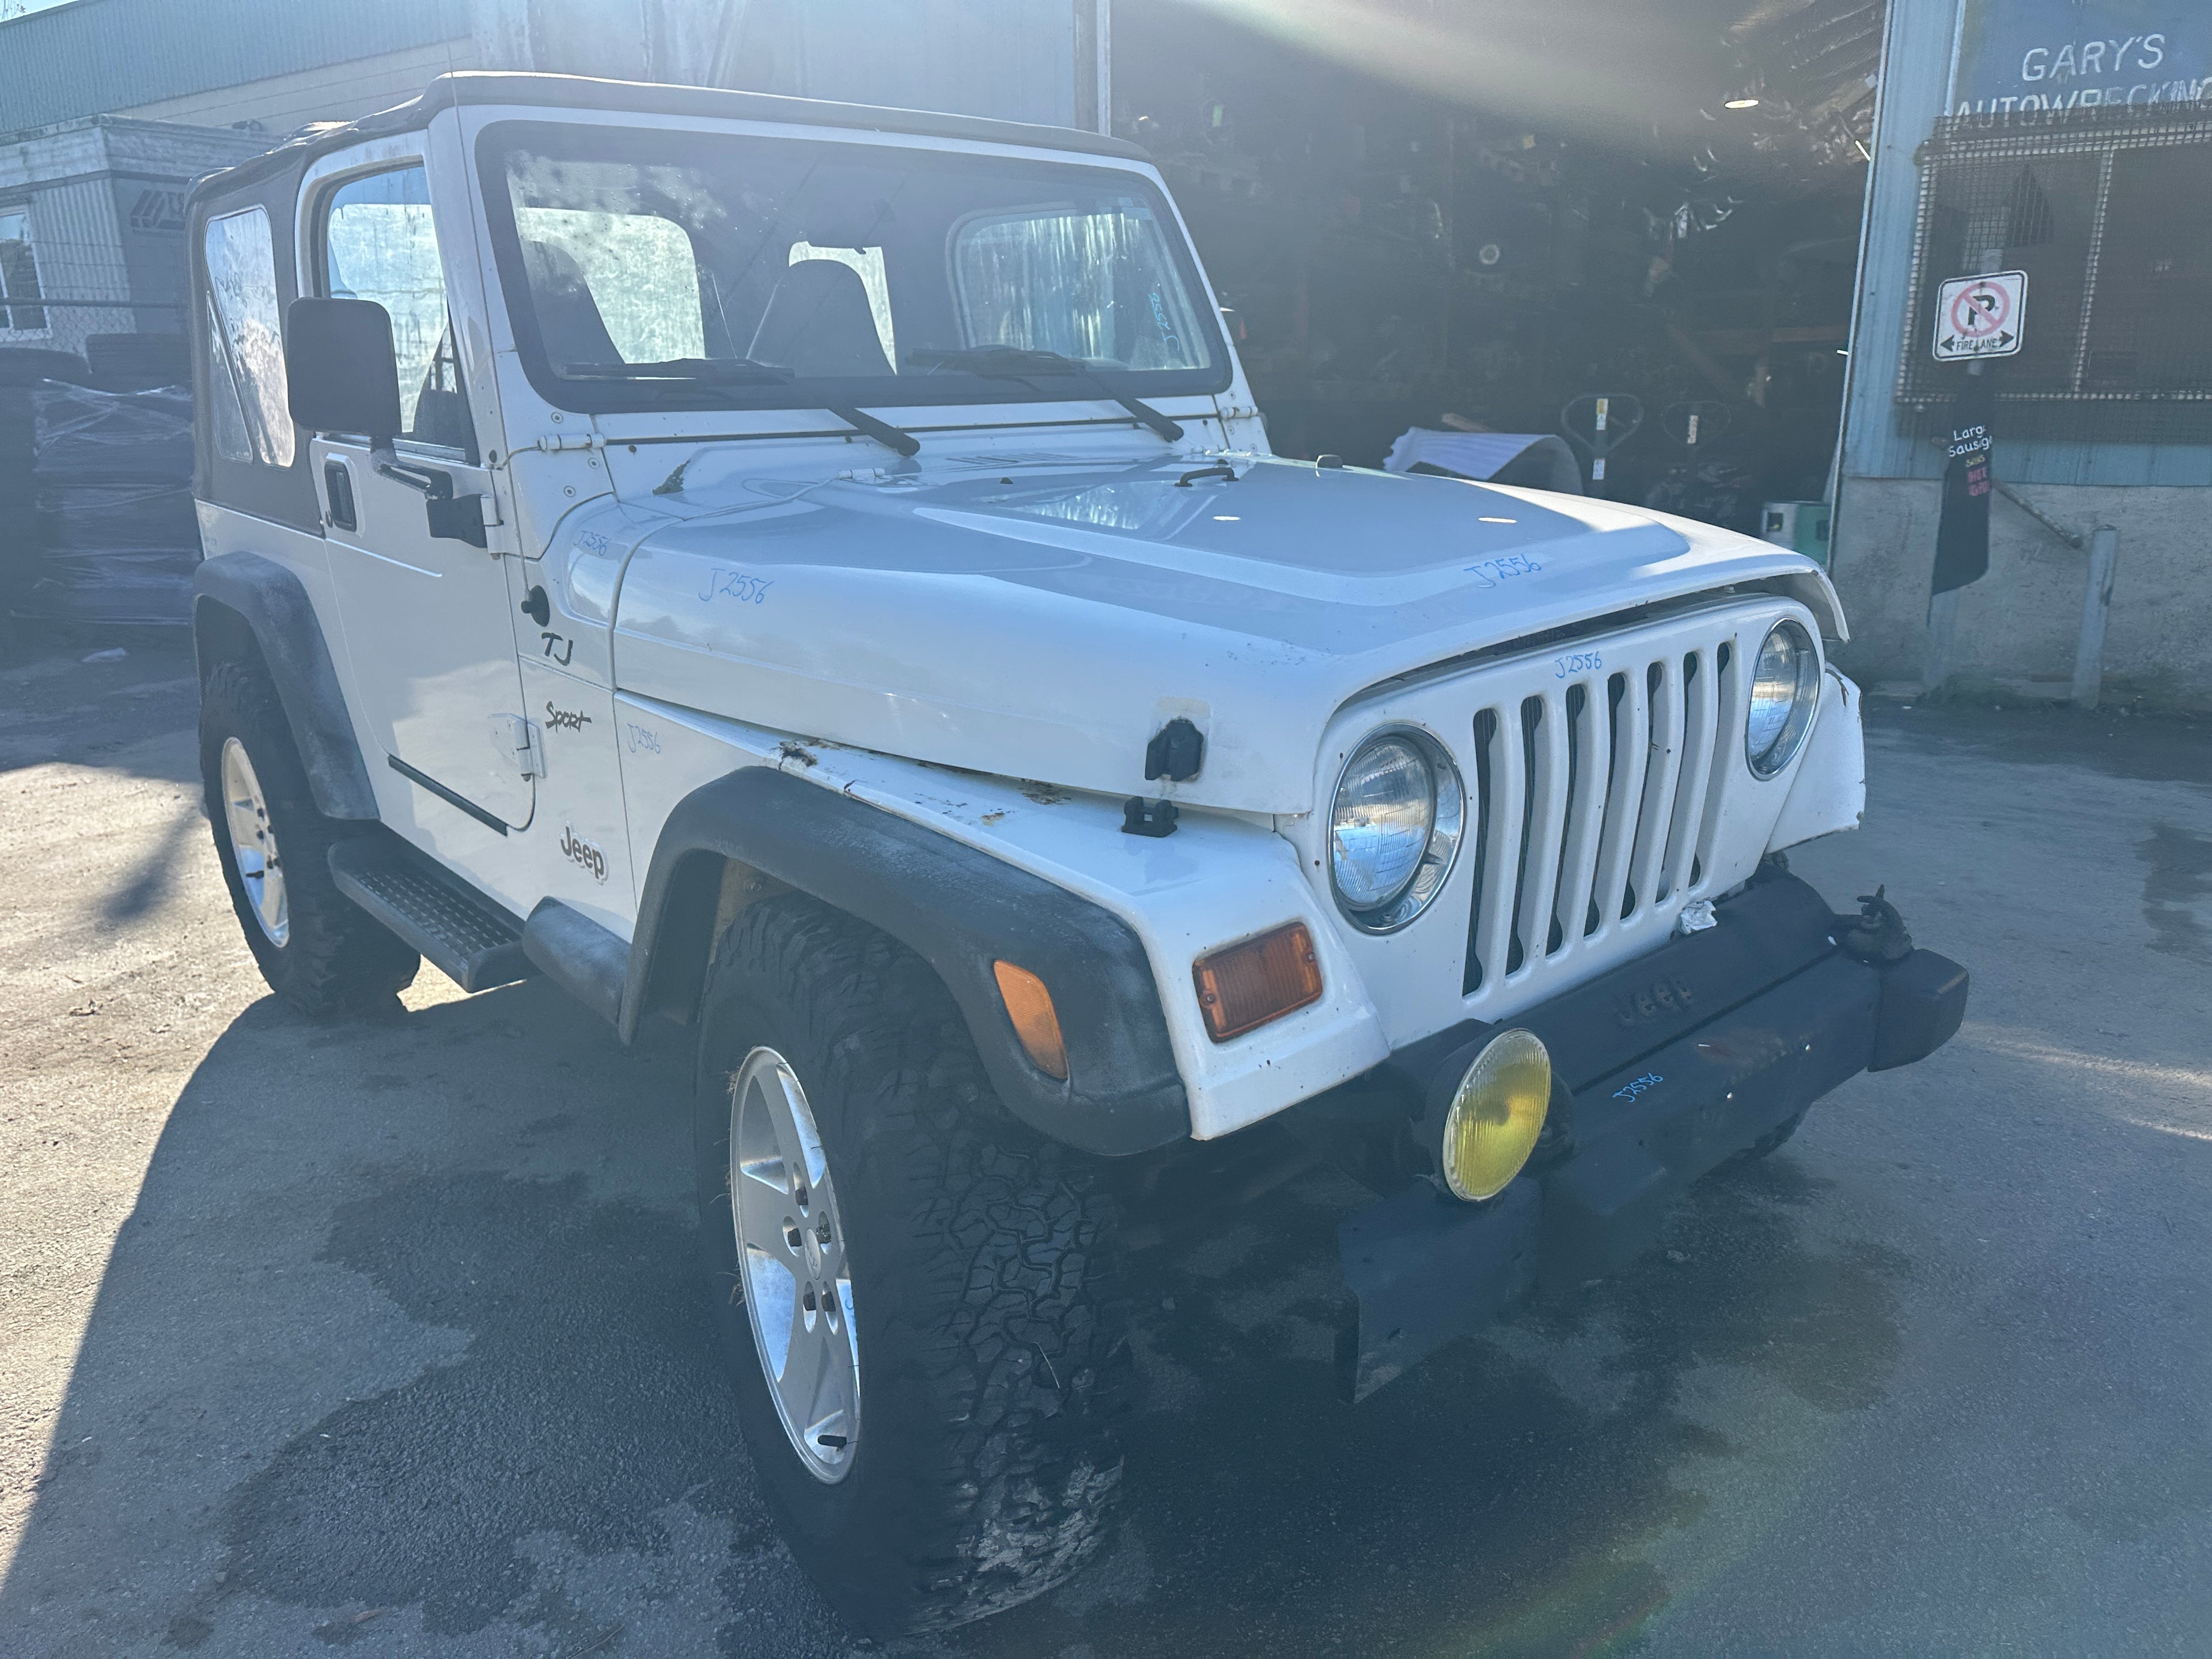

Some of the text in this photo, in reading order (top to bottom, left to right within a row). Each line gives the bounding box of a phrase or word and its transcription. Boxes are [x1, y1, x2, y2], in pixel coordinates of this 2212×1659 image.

[2021, 33, 2166, 81] GARY'S
[1956, 338, 1998, 351] FIRE LANE
[573, 530, 612, 556] J2556
[698, 567, 775, 604] J2556
[1463, 553, 1542, 589] J2556
[541, 631, 574, 666] TJ
[1554, 650, 1602, 679] J2556
[545, 700, 593, 733] Sport
[627, 722, 661, 755] J2556
[560, 825, 605, 881] Jeep
[1611, 1072, 1664, 1103] J2556
